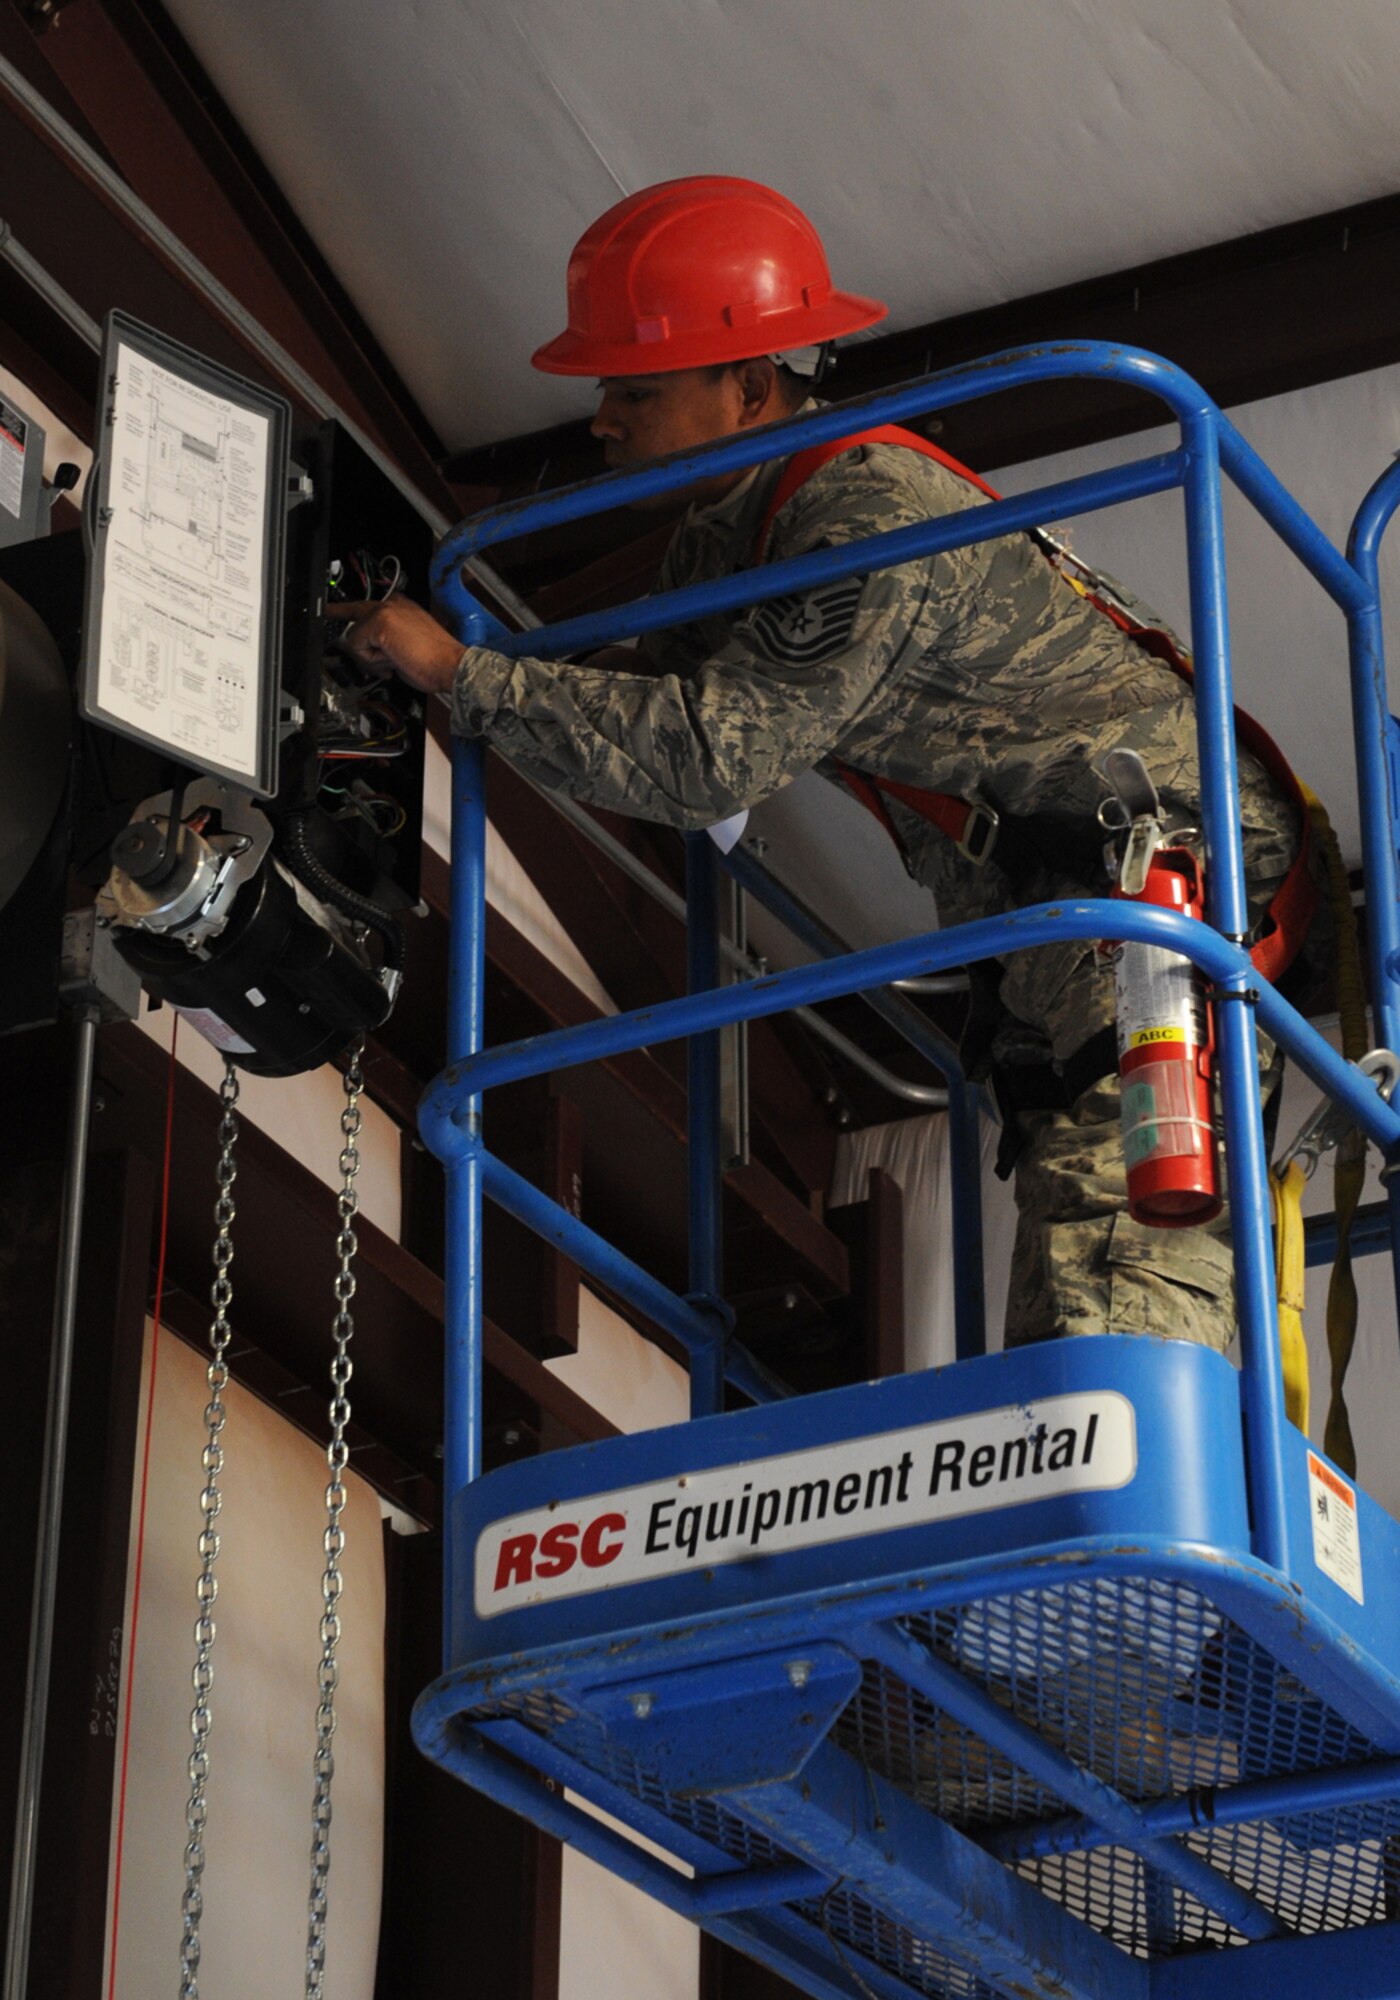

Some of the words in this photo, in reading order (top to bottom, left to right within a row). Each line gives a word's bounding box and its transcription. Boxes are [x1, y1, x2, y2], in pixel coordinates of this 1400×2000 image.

[1137, 1028, 1175, 1044] ABC
[494, 1512, 627, 1592] RSC
[643, 1450, 915, 1559] Equipment
[927, 1413, 1101, 1498] Rental
